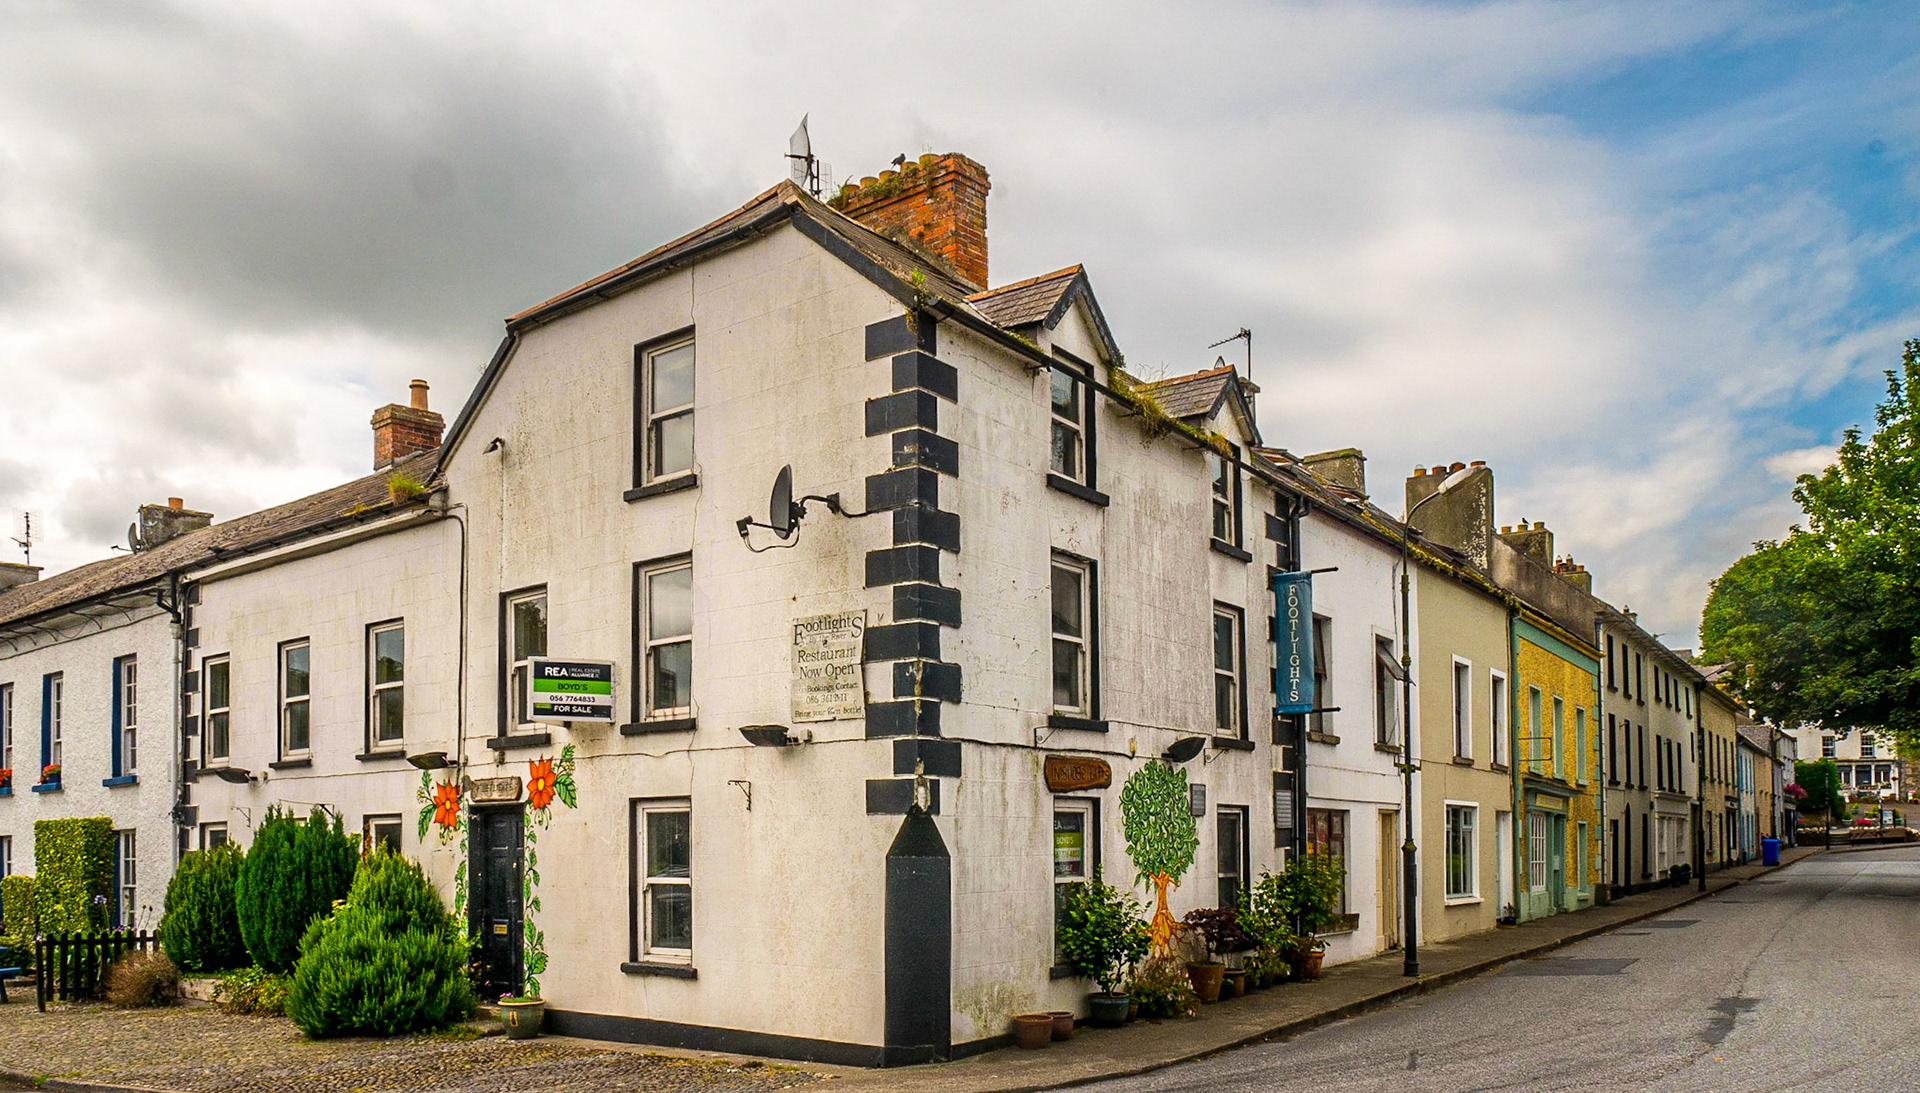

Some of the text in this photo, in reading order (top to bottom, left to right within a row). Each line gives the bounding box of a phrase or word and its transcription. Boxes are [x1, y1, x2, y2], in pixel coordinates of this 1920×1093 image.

[1287, 584, 1300, 702] FOOTLIGHTS
[798, 646, 856, 663] Restaurant
[545, 666, 569, 677] REA
[800, 663, 855, 679] Now Open
[558, 683, 588, 691] BOYD'S
[835, 682, 859, 690] Contact
